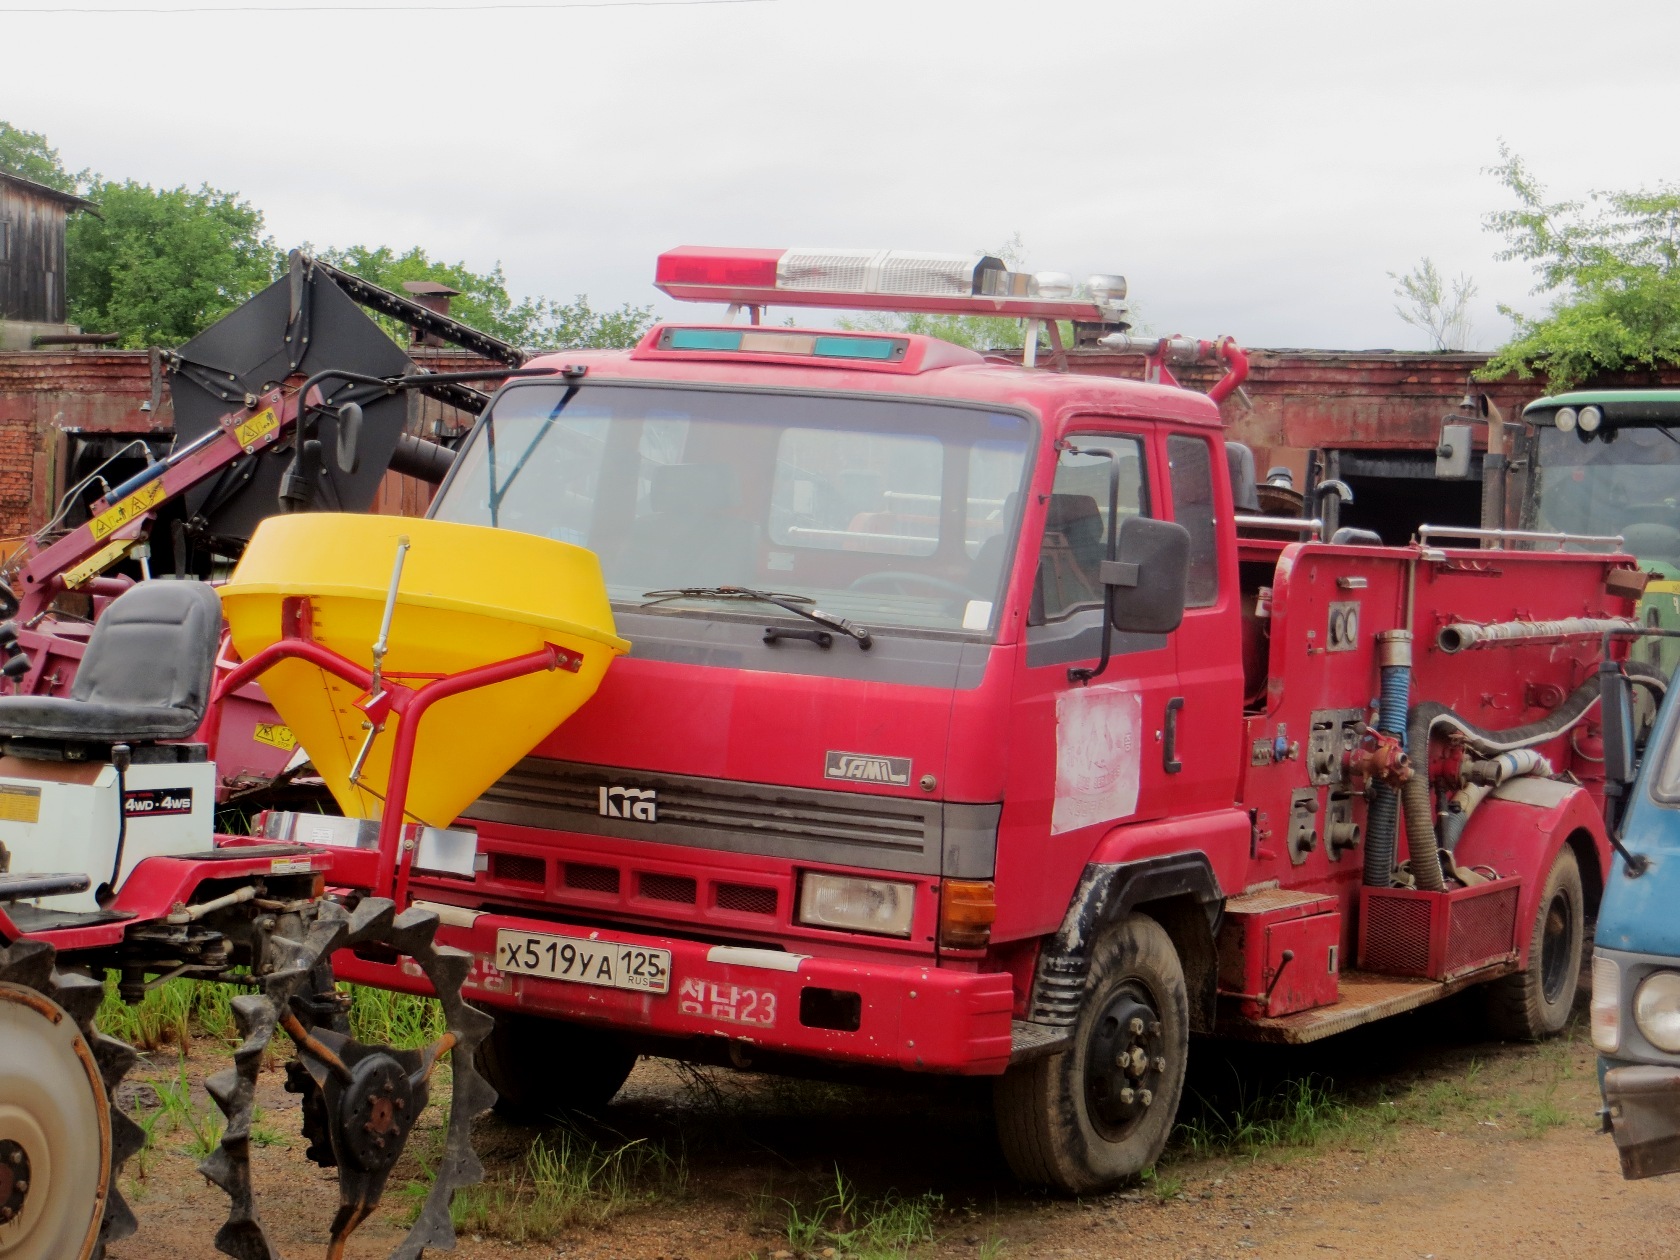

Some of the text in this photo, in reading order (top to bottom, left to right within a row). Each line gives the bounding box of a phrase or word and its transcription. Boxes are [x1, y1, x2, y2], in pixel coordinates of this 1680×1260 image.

[125, 796, 191, 811] 4WD 4WS
[621, 950, 660, 977] 125
[628, 975, 649, 986] RUS
